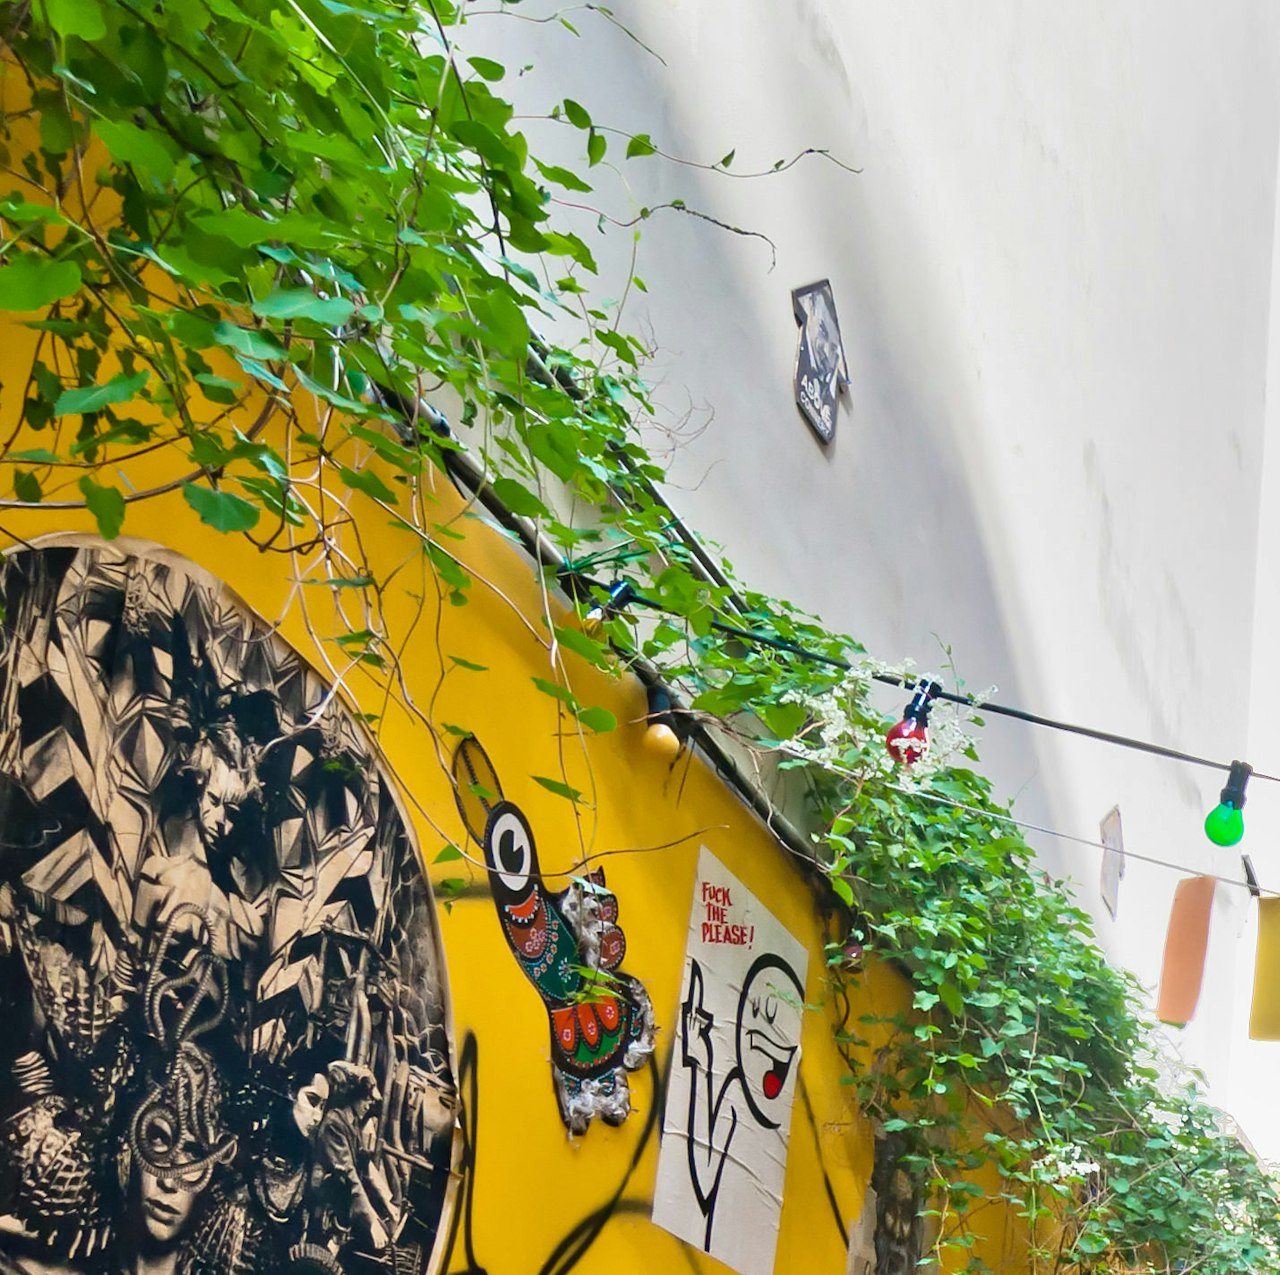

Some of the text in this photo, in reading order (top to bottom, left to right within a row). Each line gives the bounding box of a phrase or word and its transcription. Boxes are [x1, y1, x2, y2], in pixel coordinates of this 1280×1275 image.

[702, 882, 732, 906] FUCK
[706, 903, 728, 924] THE
[702, 921, 755, 950] PLEASE!
